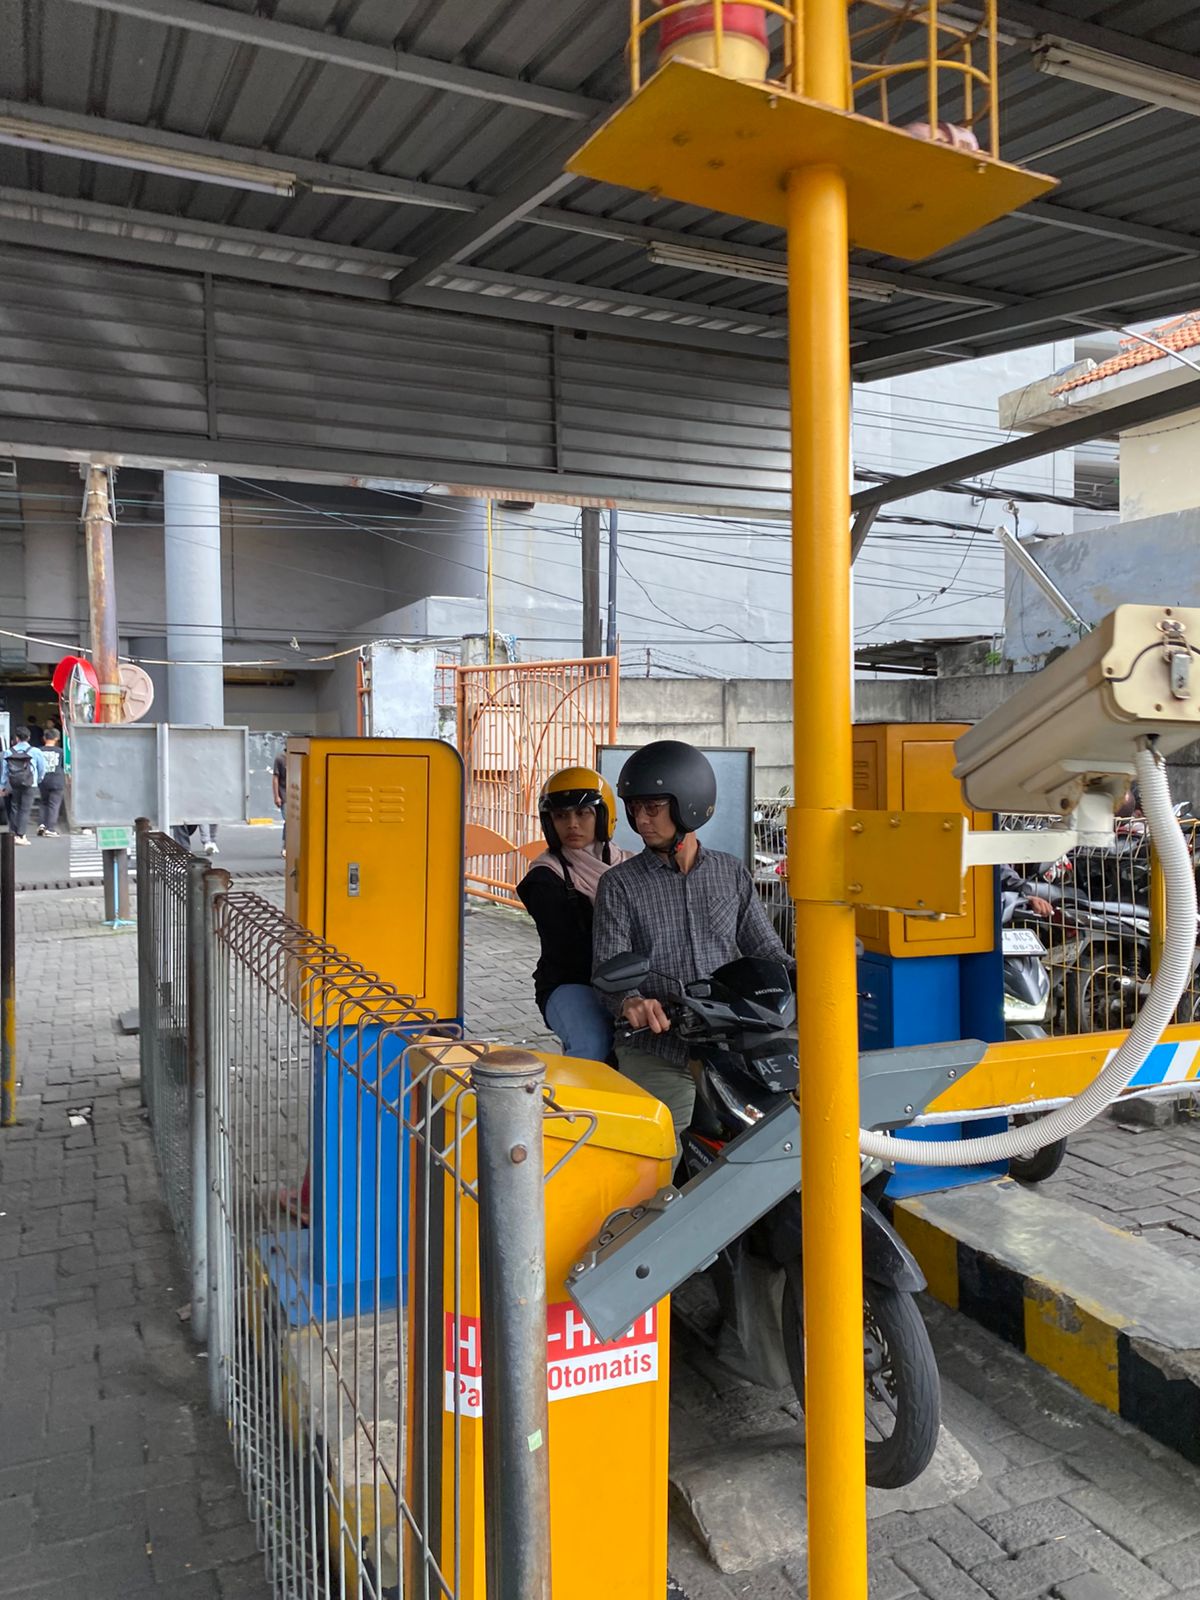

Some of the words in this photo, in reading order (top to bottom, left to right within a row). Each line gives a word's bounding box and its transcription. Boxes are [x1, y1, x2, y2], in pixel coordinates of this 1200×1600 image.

[754, 986, 785, 997] HONDA
[757, 1058, 782, 1076] AE
[547, 1350, 652, 1391] Otomatis
